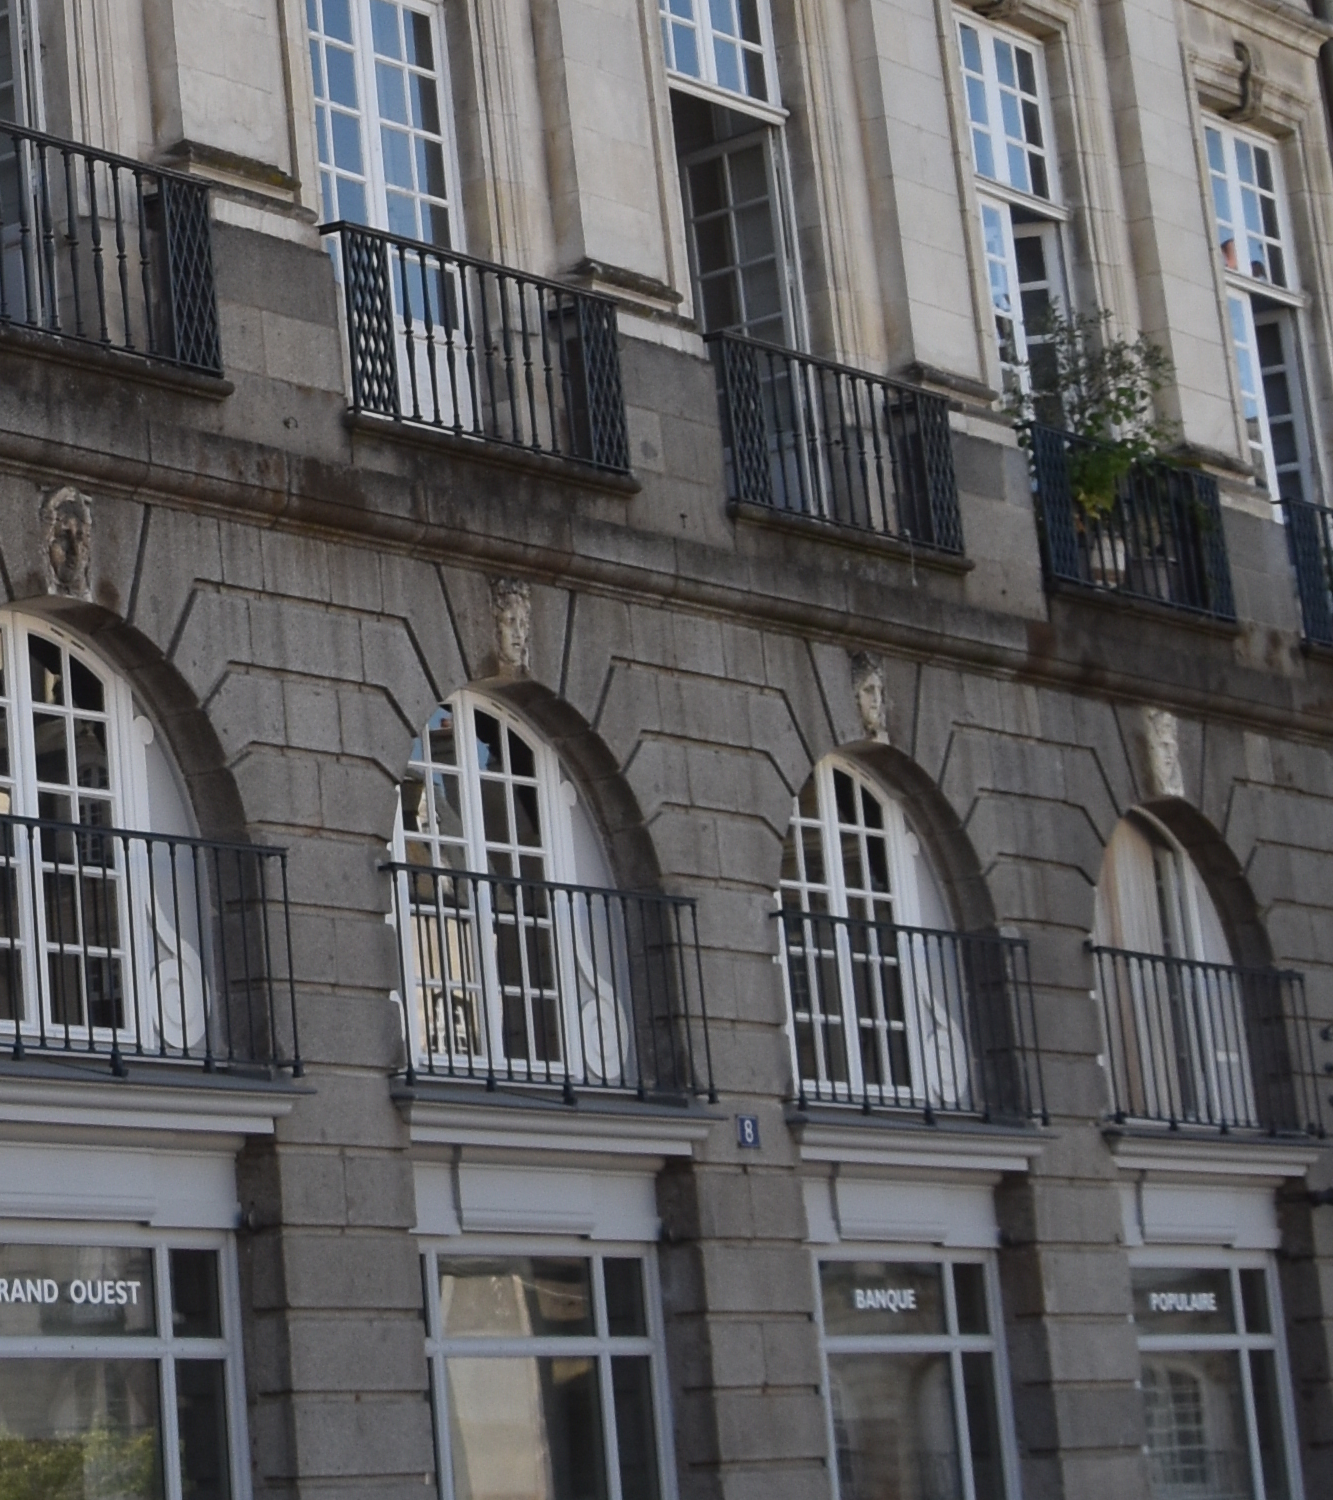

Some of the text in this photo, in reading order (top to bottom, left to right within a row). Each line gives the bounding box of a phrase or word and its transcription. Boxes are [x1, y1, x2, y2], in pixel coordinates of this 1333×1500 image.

[744, 1119, 754, 1143] 8
[70, 1280, 140, 1304] OUEST
[855, 1288, 916, 1313] BANQUE
[1150, 1292, 1217, 1312] POPULAIRE
